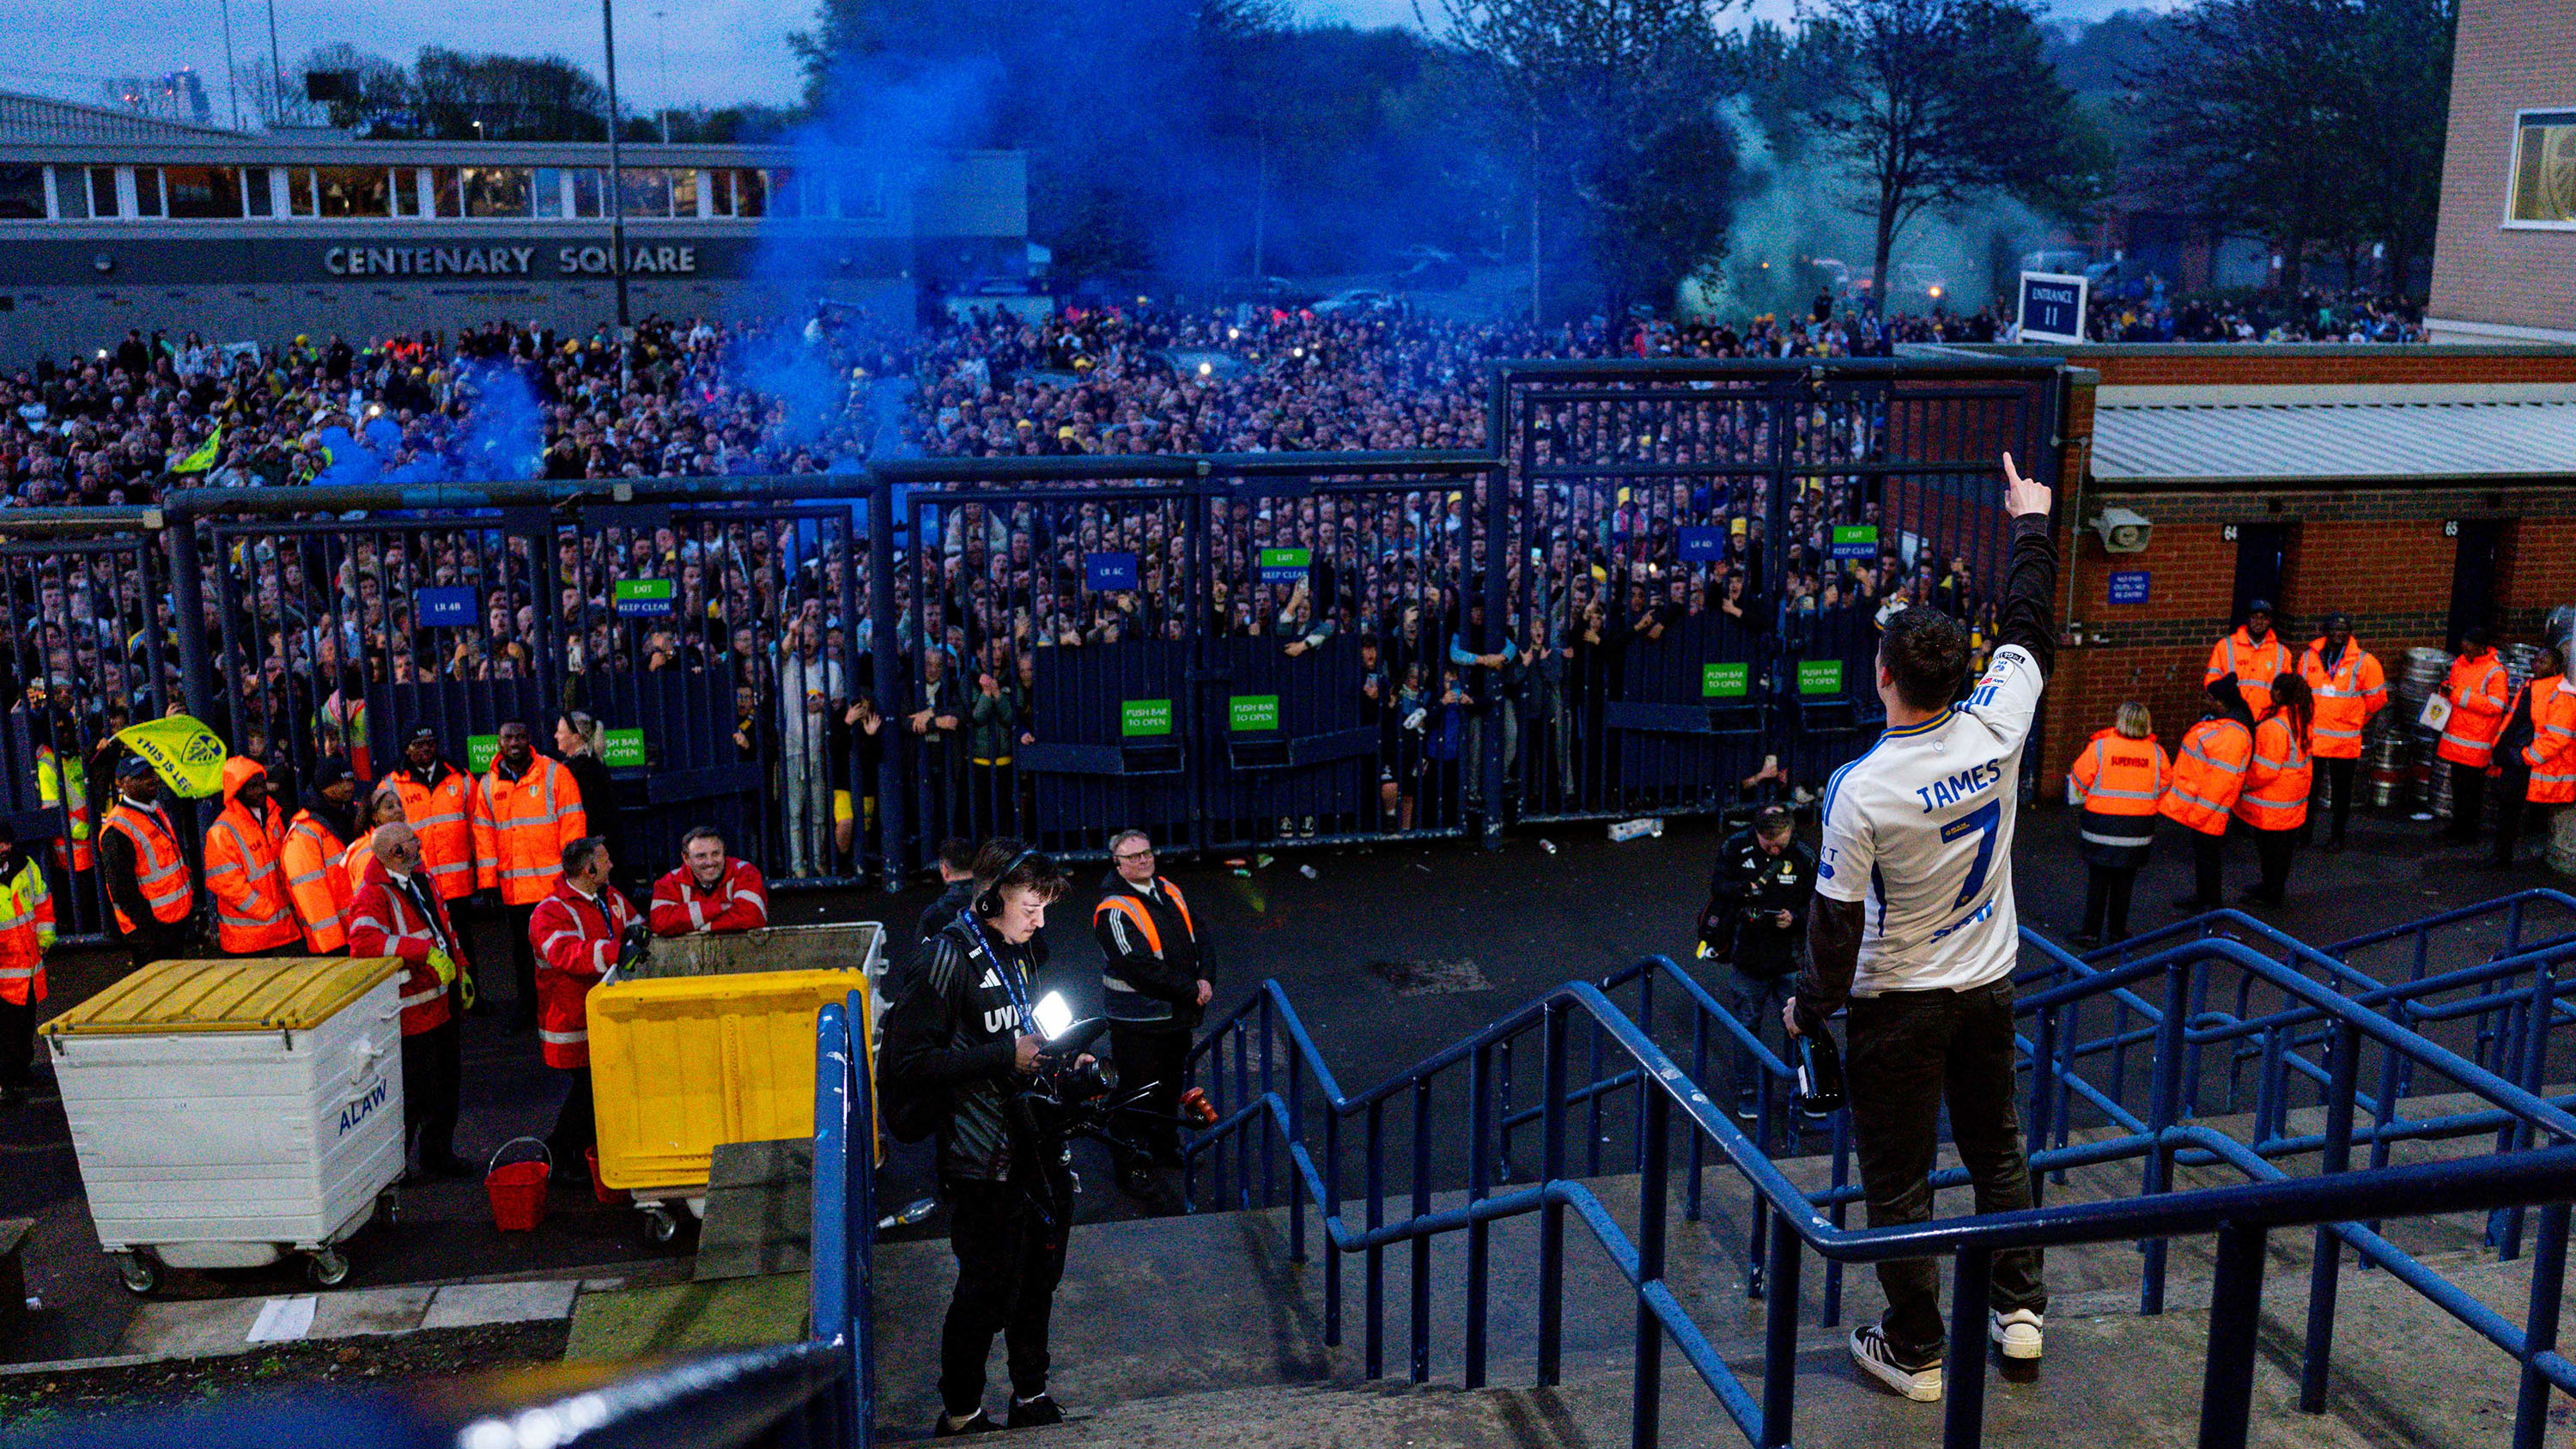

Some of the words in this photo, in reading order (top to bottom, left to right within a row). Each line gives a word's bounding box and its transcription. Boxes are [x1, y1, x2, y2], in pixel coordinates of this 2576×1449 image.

[324, 247, 534, 275] CENTENARY
[559, 247, 696, 273] SQUARE
[2032, 287, 2074, 304] ENTRANCE
[2044, 305, 2058, 326] 11
[2224, 525, 2238, 540] 64
[1852, 546, 1875, 555] CLEAR
[1277, 553, 1293, 562] EXIT
[1100, 568, 1110, 576] LR
[1262, 570, 1281, 579] KEEP
[634, 584, 653, 594] EXIT
[435, 603, 447, 612] LR
[448, 602, 461, 612] 4B
[619, 604, 640, 612] KEEP
[641, 602, 670, 612] CLEAR
[1801, 668, 1822, 677] PUSH
[1721, 679, 1741, 688] OPEN
[1126, 709, 1149, 717] PUSH
[1151, 708, 1168, 716] BAR
[1236, 714, 1248, 722] TO
[1249, 713, 1273, 721] OPEN
[1142, 718, 1166, 727] OPEN
[621, 737, 640, 747] BAR
[137, 737, 165, 762] THIS
[162, 759, 174, 772] IS
[612, 749, 638, 758] OPEN
[476, 755, 489, 764] TO
[2111, 755, 2149, 769] SUPERVISOR
[1916, 758, 2002, 814] JAMES
[1940, 797, 2002, 913] 7
[339, 1076, 386, 1137] ALAW
